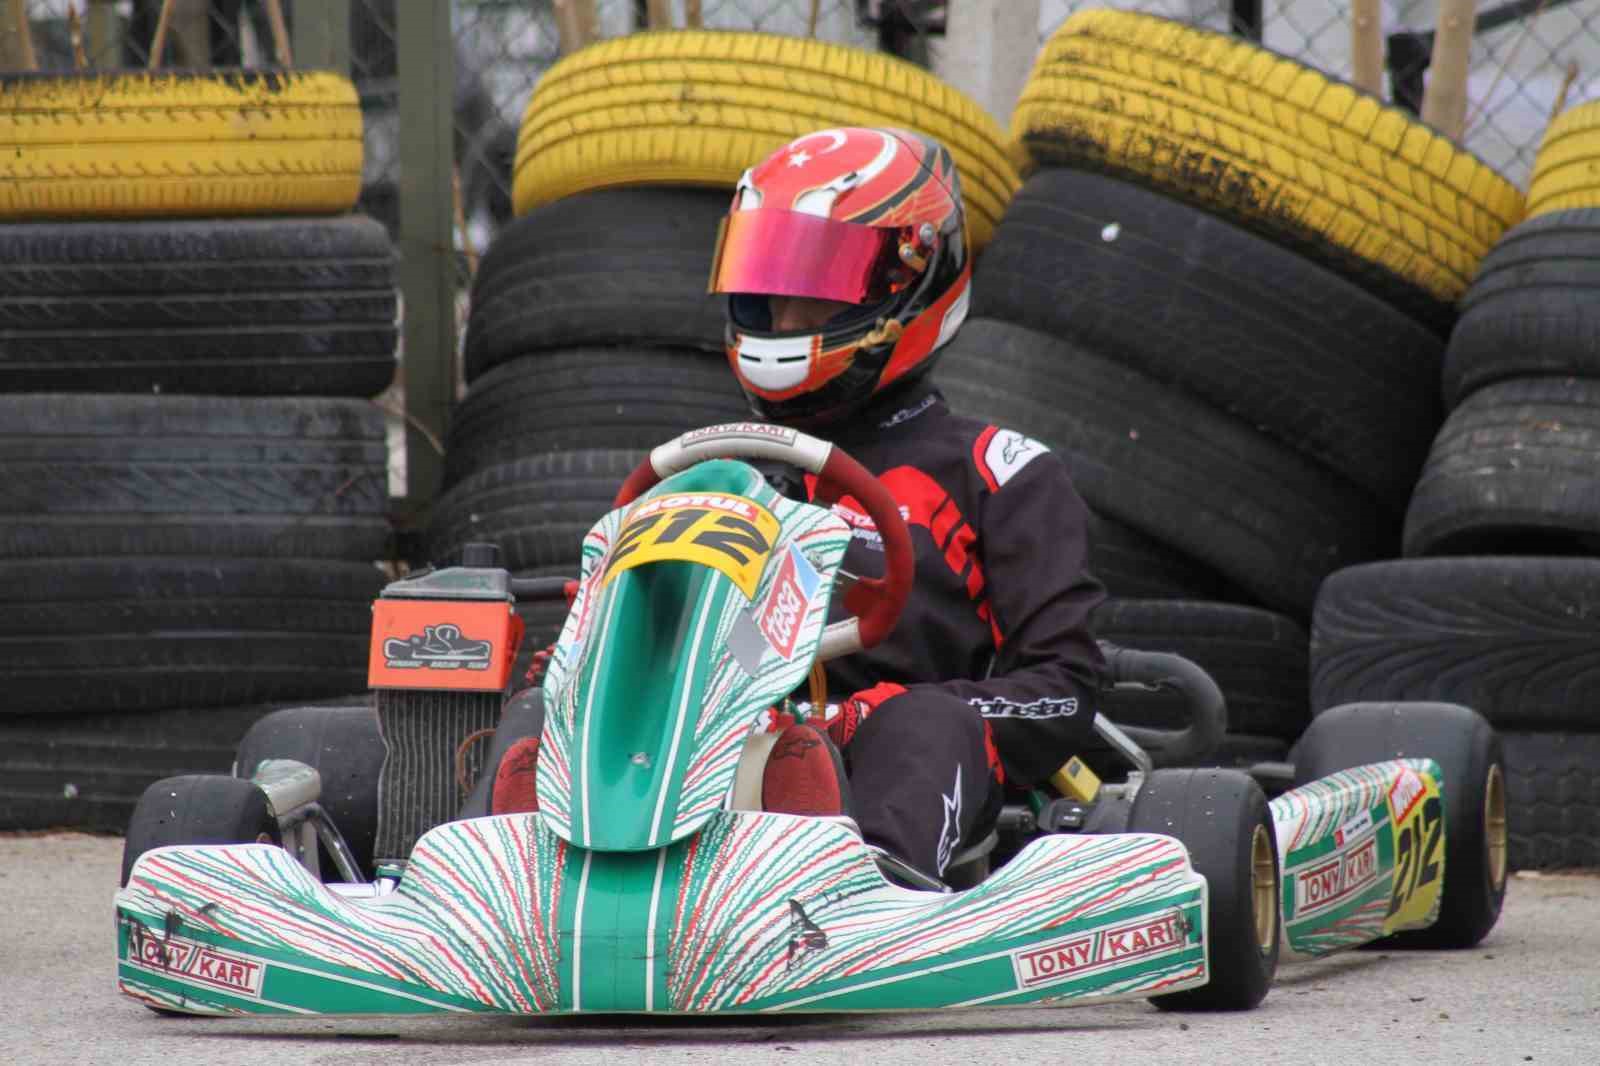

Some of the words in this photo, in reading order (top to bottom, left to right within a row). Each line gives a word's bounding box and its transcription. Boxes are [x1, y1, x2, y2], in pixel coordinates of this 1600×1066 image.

[601, 509, 770, 577] 212
[1300, 861, 1340, 904] TONY
[1386, 797, 1441, 919] 212
[201, 951, 259, 987] KART
[1019, 938, 1091, 976] TONY
[1106, 912, 1180, 956] KART
